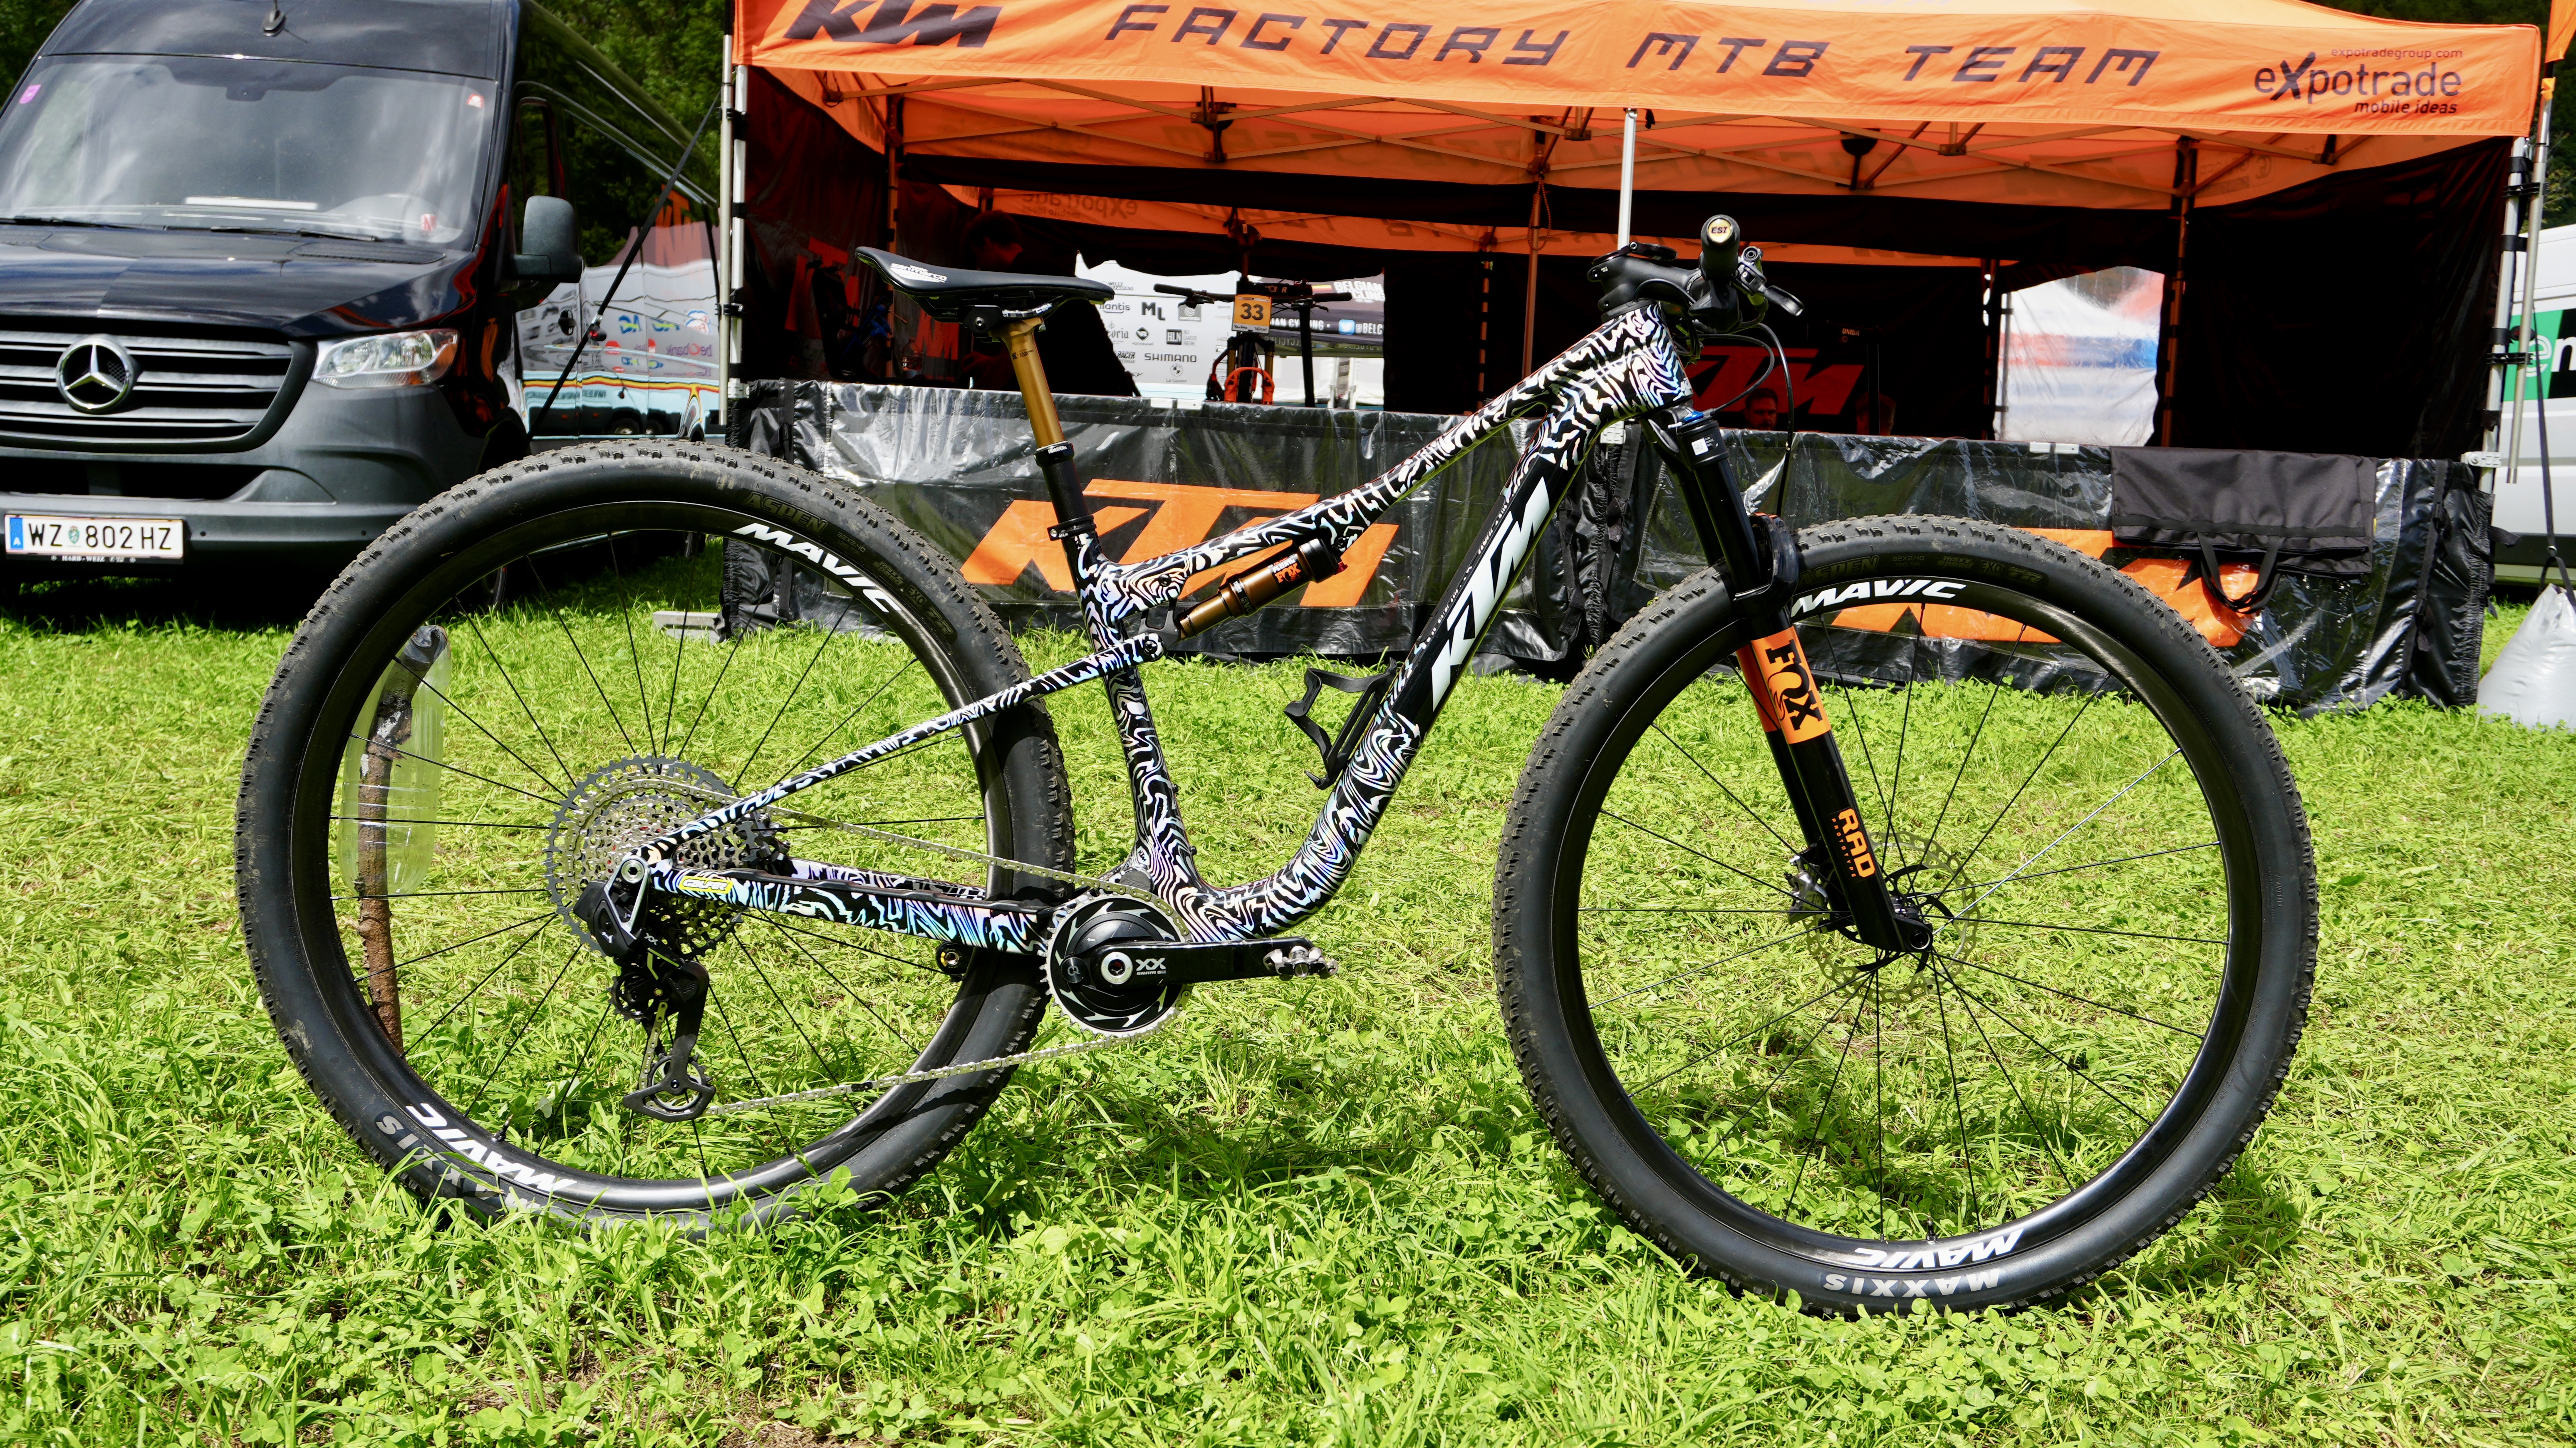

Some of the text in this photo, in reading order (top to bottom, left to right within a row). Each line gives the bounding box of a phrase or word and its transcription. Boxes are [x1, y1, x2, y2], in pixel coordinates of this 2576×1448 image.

[782, 0, 1003, 48] KTM
[1104, 4, 2161, 87] FACTORY MTB TEAM
[2331, 48, 2463, 60] expotradegroup.com
[2354, 100, 2458, 114] mobile ideas
[1333, 281, 1384, 292] BELGIAN
[1240, 303, 1263, 320] 33
[1167, 331, 1181, 342] HLN
[1355, 322, 1384, 335] @BELC
[1144, 352, 1197, 362] SHIMANO
[743, 491, 828, 535] ASPEN
[28, 523, 171, 550] WZ 802 HZ
[731, 523, 902, 613] MAVIC
[1274, 563, 1302, 583] FOX
[1797, 555, 1880, 588] ASPEN
[1980, 560, 2003, 575] EXO
[2008, 566, 2043, 582] TR
[907, 585, 926, 605] EXO
[1431, 476, 1550, 713] KTM
[1791, 579, 1967, 617] MAVIC
[926, 606, 953, 635] TR
[1765, 638, 1823, 731] FOX
[1138, 850, 1147, 863] KTM
[1831, 818, 1856, 877] PROTOTYPE
[1838, 808, 1875, 878] RAD
[1135, 957, 1167, 971] XX
[405, 1103, 578, 1192] MAVIC
[1845, 1228, 2024, 1269] MAVIC
[1823, 1268, 2000, 1298] MAXXIS
